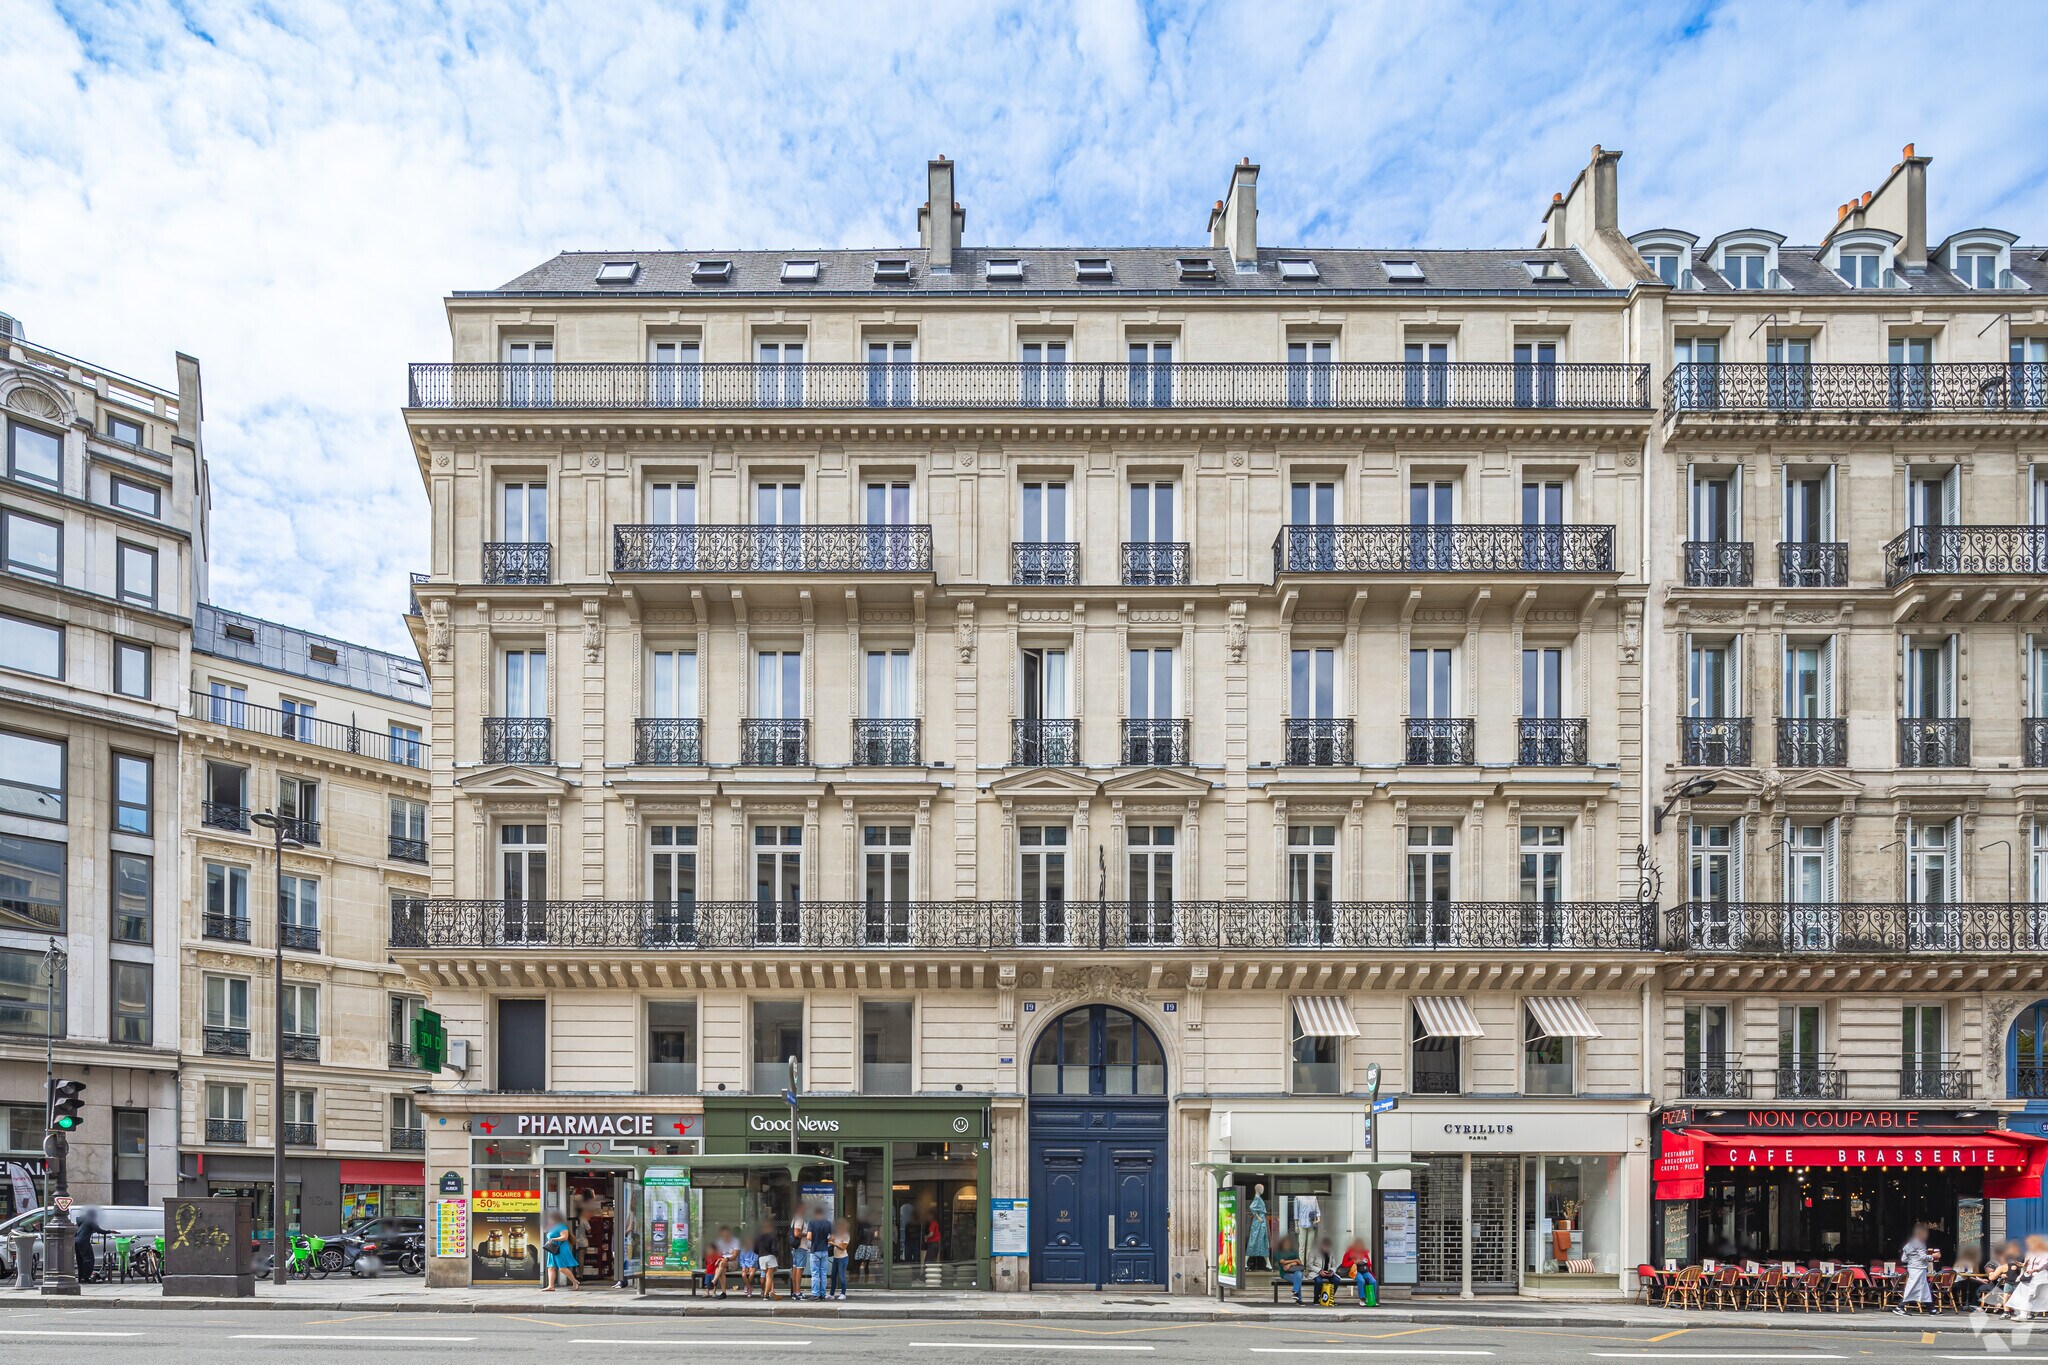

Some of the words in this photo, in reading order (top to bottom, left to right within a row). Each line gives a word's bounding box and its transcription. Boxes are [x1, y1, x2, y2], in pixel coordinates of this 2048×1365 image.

[1025, 1003, 1034, 1011] 19
[1166, 1003, 1175, 1011] 19
[1367, 1069, 1377, 1080] BUS
[1662, 1109, 1688, 1124] PIZZA
[1748, 1111, 1795, 1127] NON
[1803, 1111, 1919, 1128] COUPABLE
[518, 1115, 653, 1135] PHARMACIE
[1444, 1124, 1513, 1134] CYRILLUS
[1729, 1149, 1793, 1162] CAFE
[1838, 1149, 1994, 1163] BRASSERIE
[477, 1199, 500, 1208] -50%
